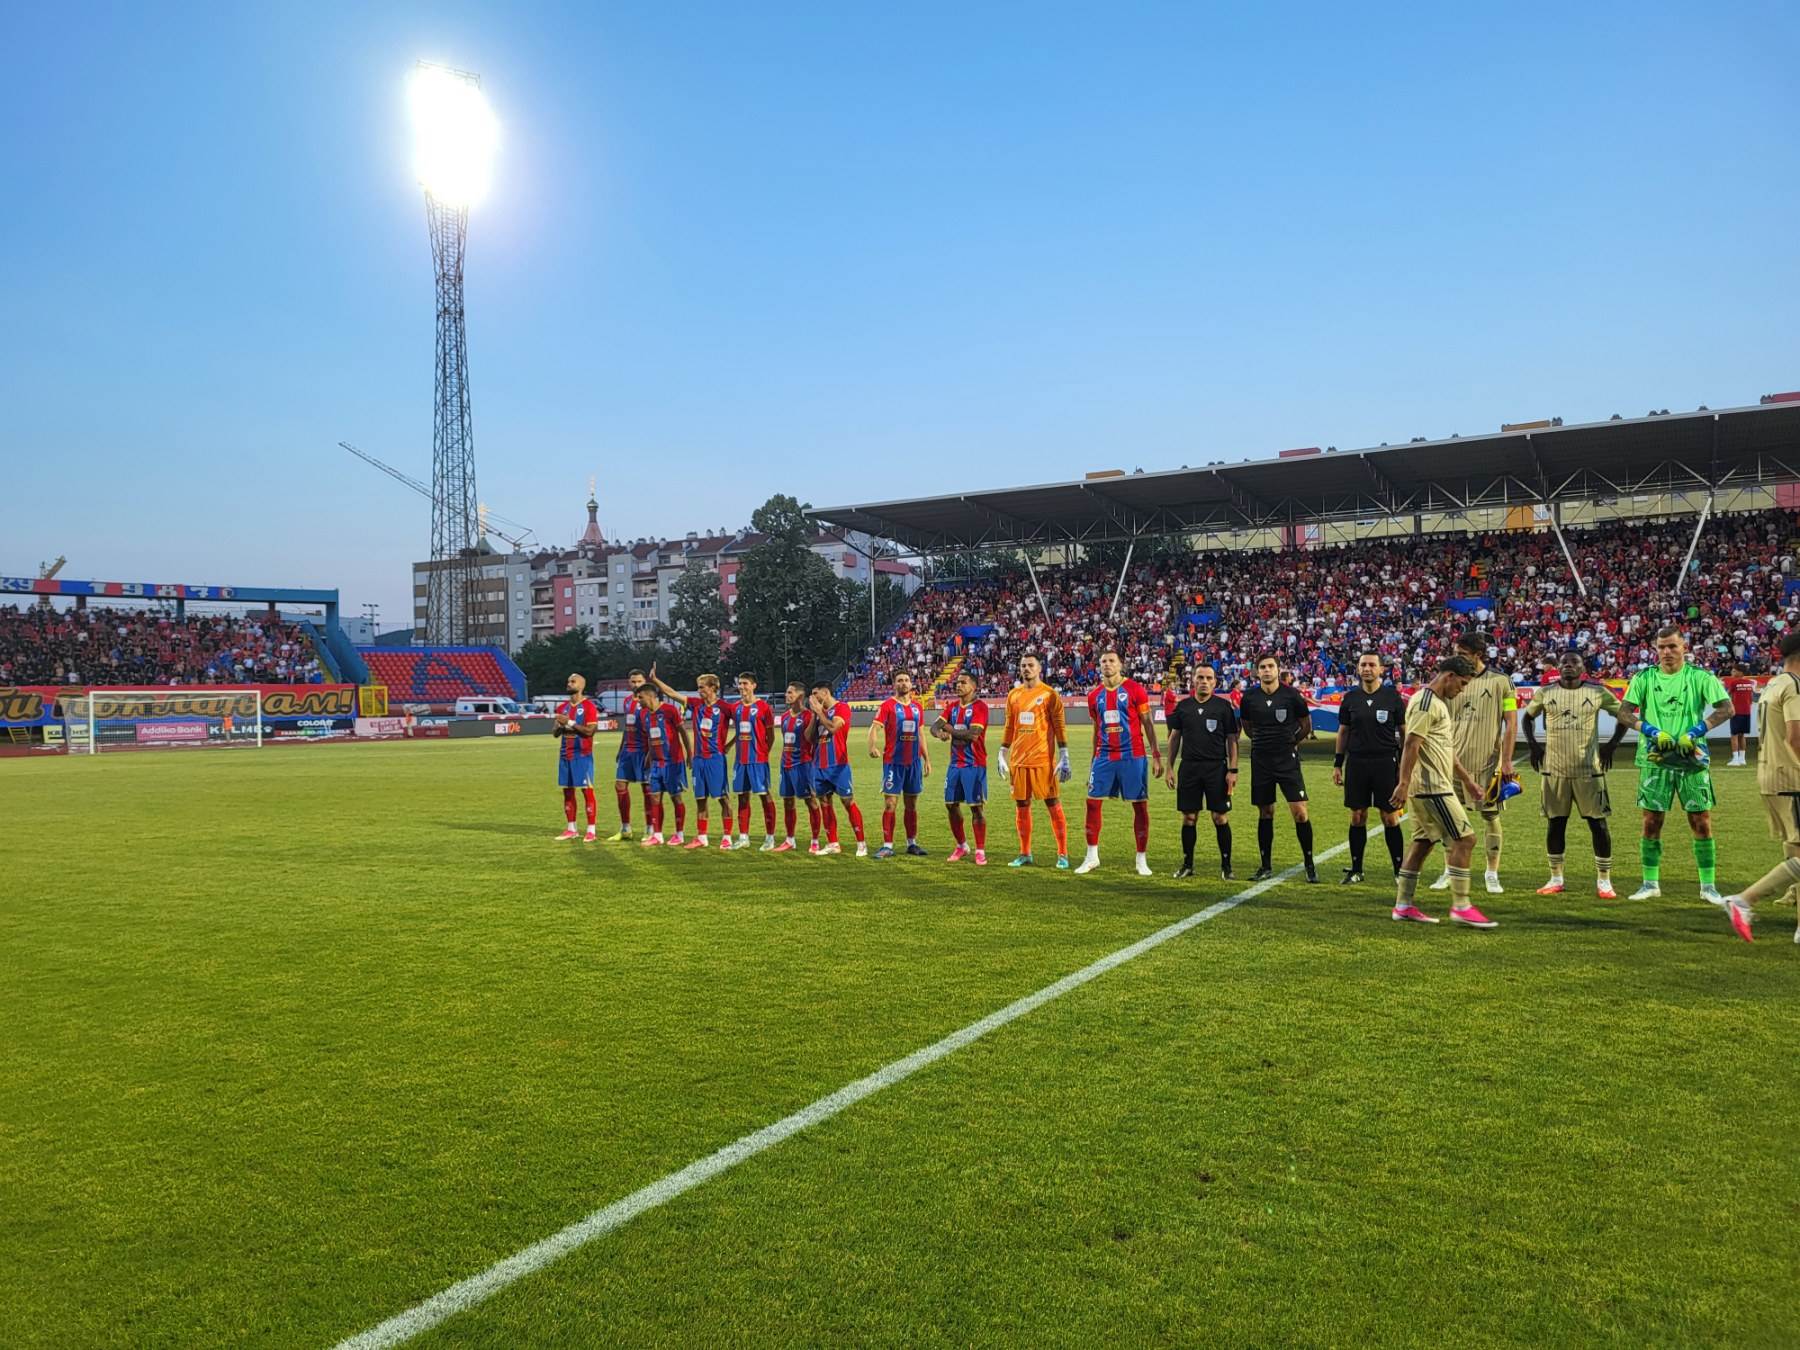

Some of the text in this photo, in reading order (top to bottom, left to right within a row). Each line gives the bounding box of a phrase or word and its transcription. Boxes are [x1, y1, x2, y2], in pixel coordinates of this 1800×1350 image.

[89, 583, 209, 599] 1987
[141, 726, 176, 735] Addiko
[177, 725, 202, 734] Bank
[209, 725, 261, 735] KLME
